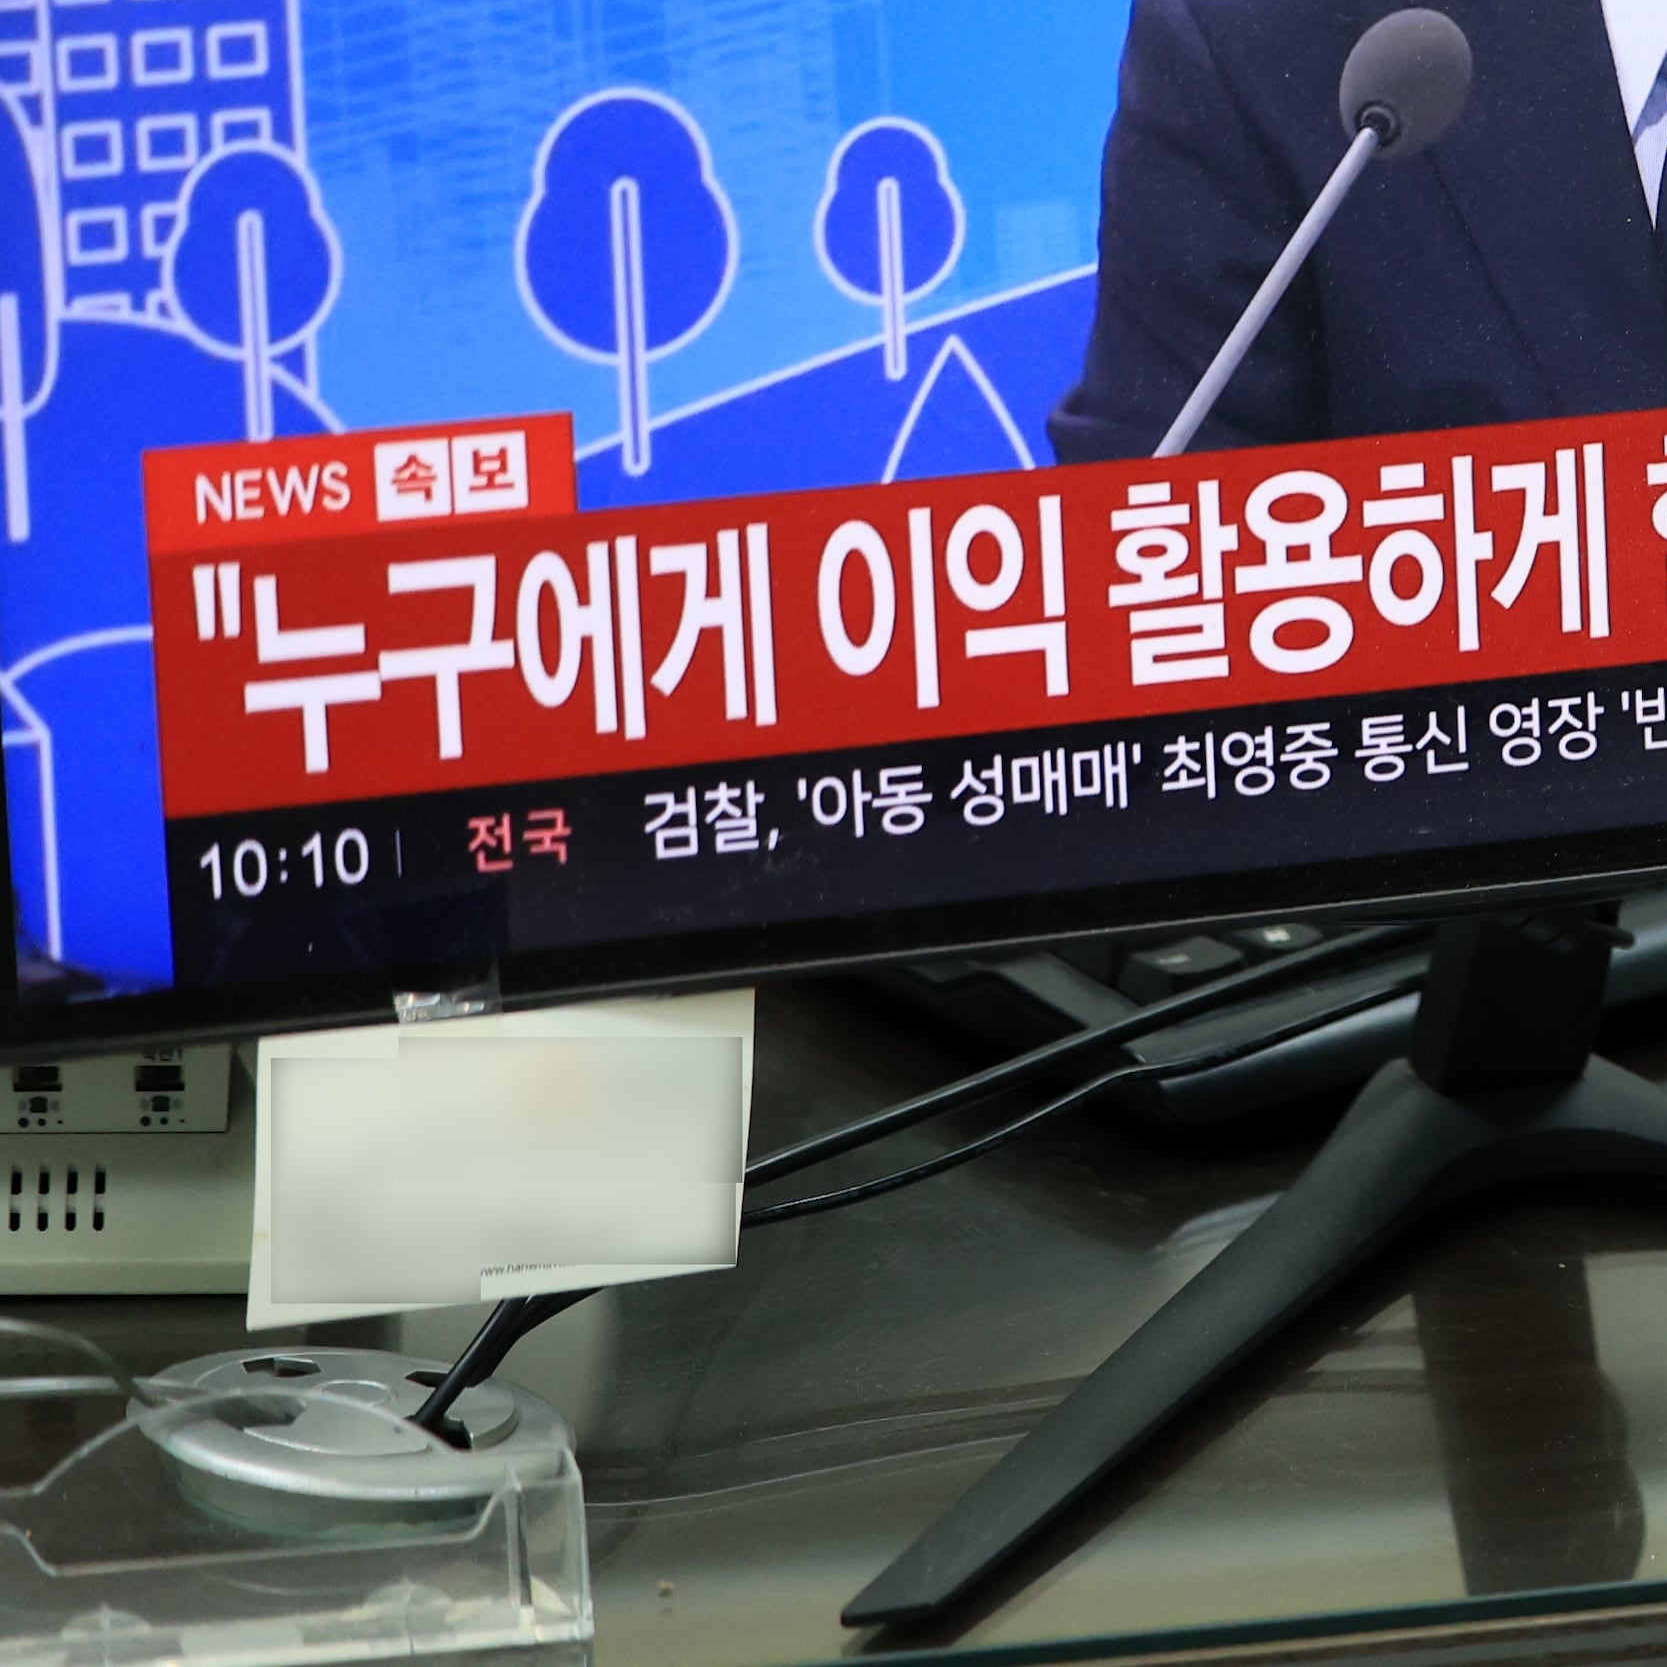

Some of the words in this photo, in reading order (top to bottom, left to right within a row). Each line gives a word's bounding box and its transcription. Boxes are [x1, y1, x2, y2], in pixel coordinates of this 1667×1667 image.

[194, 463, 351, 523] NEWS
[390, 446, 517, 505] 속보
[192, 521, 777, 774] "누구에게
[816, 494, 1070, 710] 이익
[1107, 442, 1610, 687] 활용하게
[643, 779, 782, 861] 검찰,
[796, 763, 934, 839] '아동
[951, 742, 1144, 825] 성매매'
[1161, 722, 1340, 801] 최영중
[1353, 704, 1470, 783] 통신
[1487, 689, 1605, 767] 영장
[200, 826, 370, 903] 10:10
[467, 807, 573, 874] 전국
